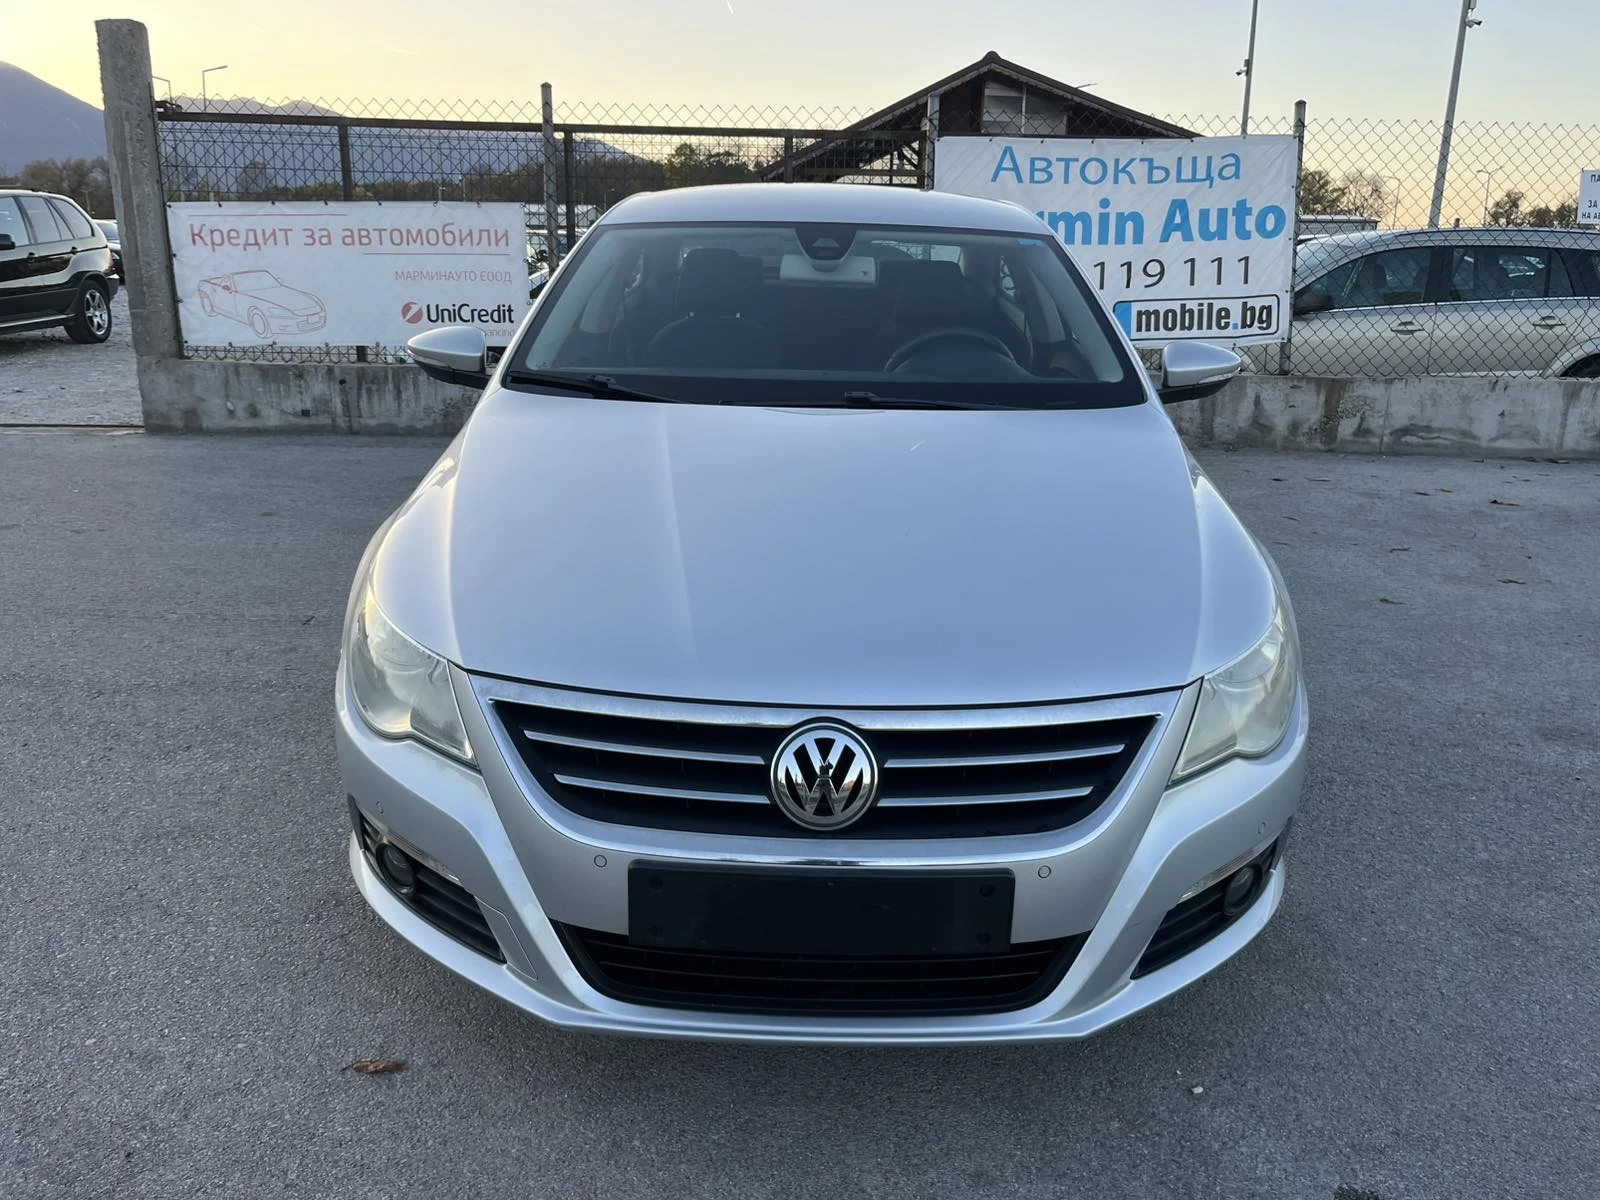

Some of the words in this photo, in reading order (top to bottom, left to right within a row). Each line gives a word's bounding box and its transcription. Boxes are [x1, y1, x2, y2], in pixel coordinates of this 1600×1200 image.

[991, 145, 1242, 188] Автокъща
[1159, 198, 1287, 243] Auto
[189, 223, 294, 252] Кредит
[302, 227, 332, 246] за
[341, 222, 510, 247] автомобили
[395, 270, 477, 281] МАРМИНАУТО
[426, 303, 514, 323] UniCredit
[1135, 301, 1273, 332] mobile.bg
